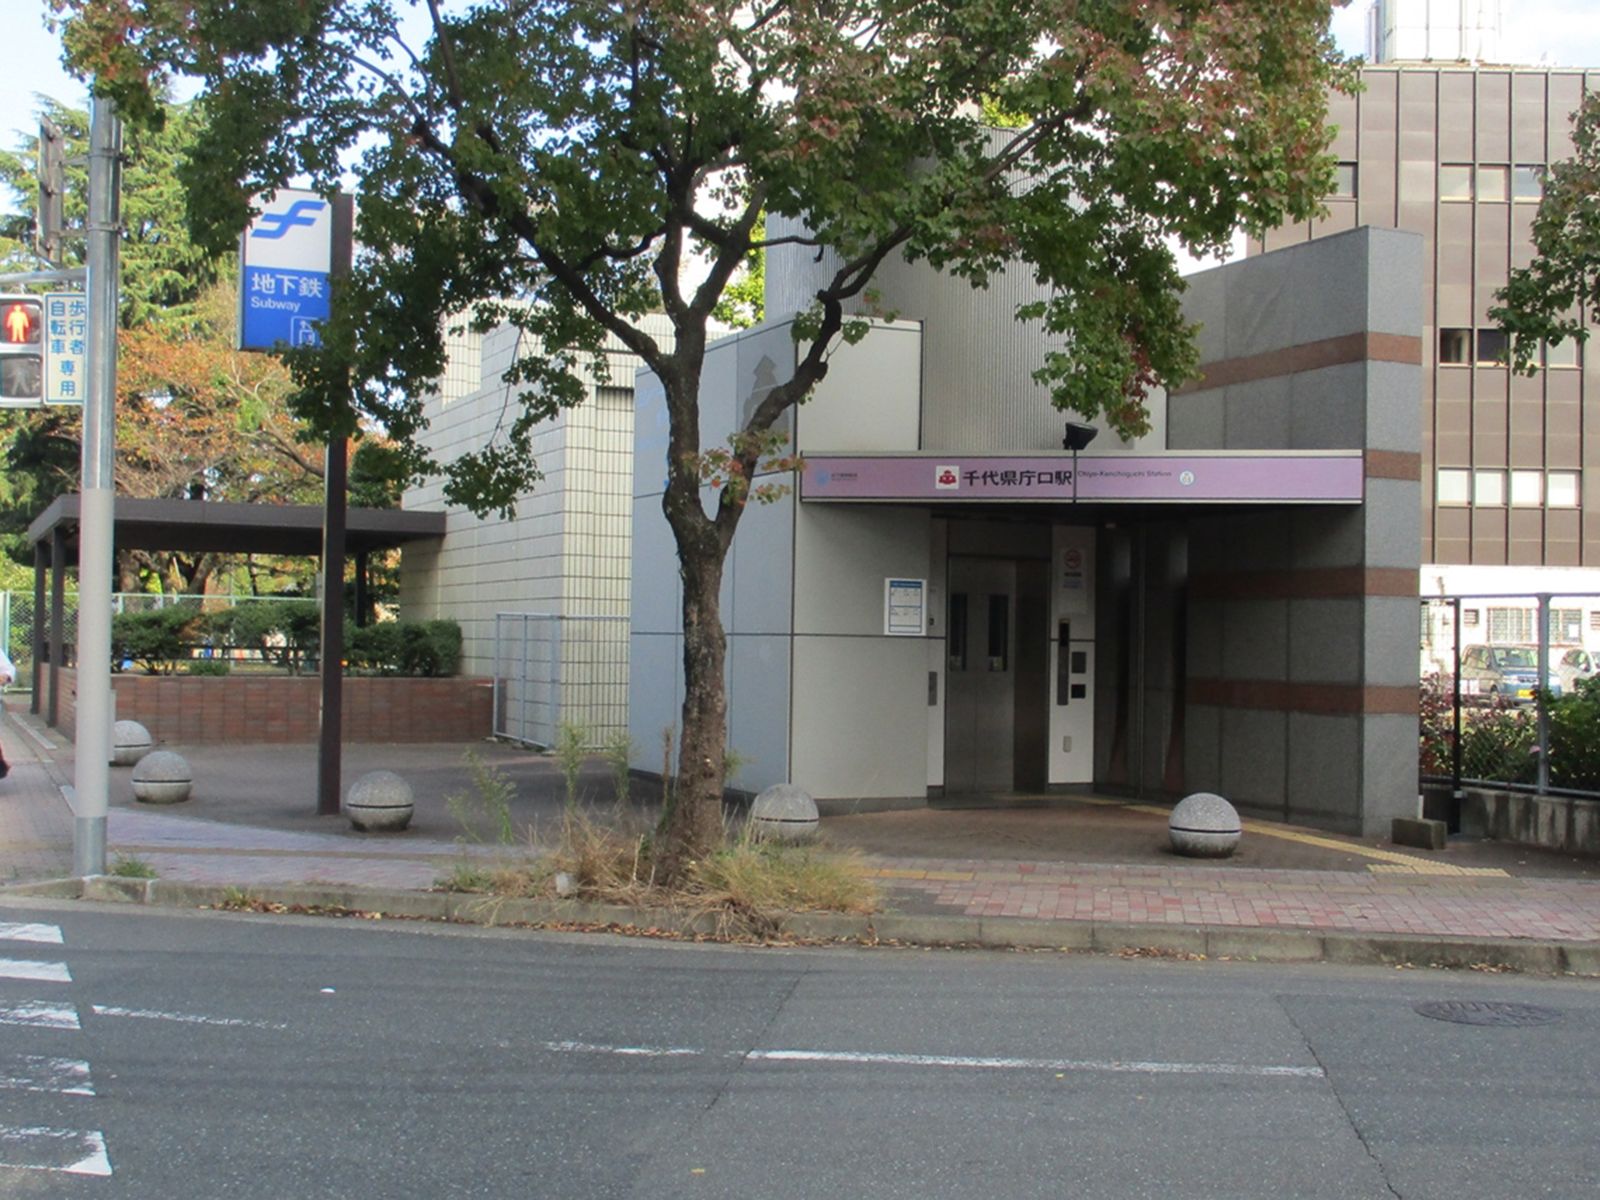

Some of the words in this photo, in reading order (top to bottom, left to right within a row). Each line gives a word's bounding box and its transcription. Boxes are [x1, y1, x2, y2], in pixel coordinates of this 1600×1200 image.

[251, 272, 323, 298] 地下鉄
[251, 296, 301, 313] Subway
[51, 300, 66, 354] 自転車
[60, 360, 76, 396] 専用
[963, 470, 1072, 487] 千代県庁口駅
